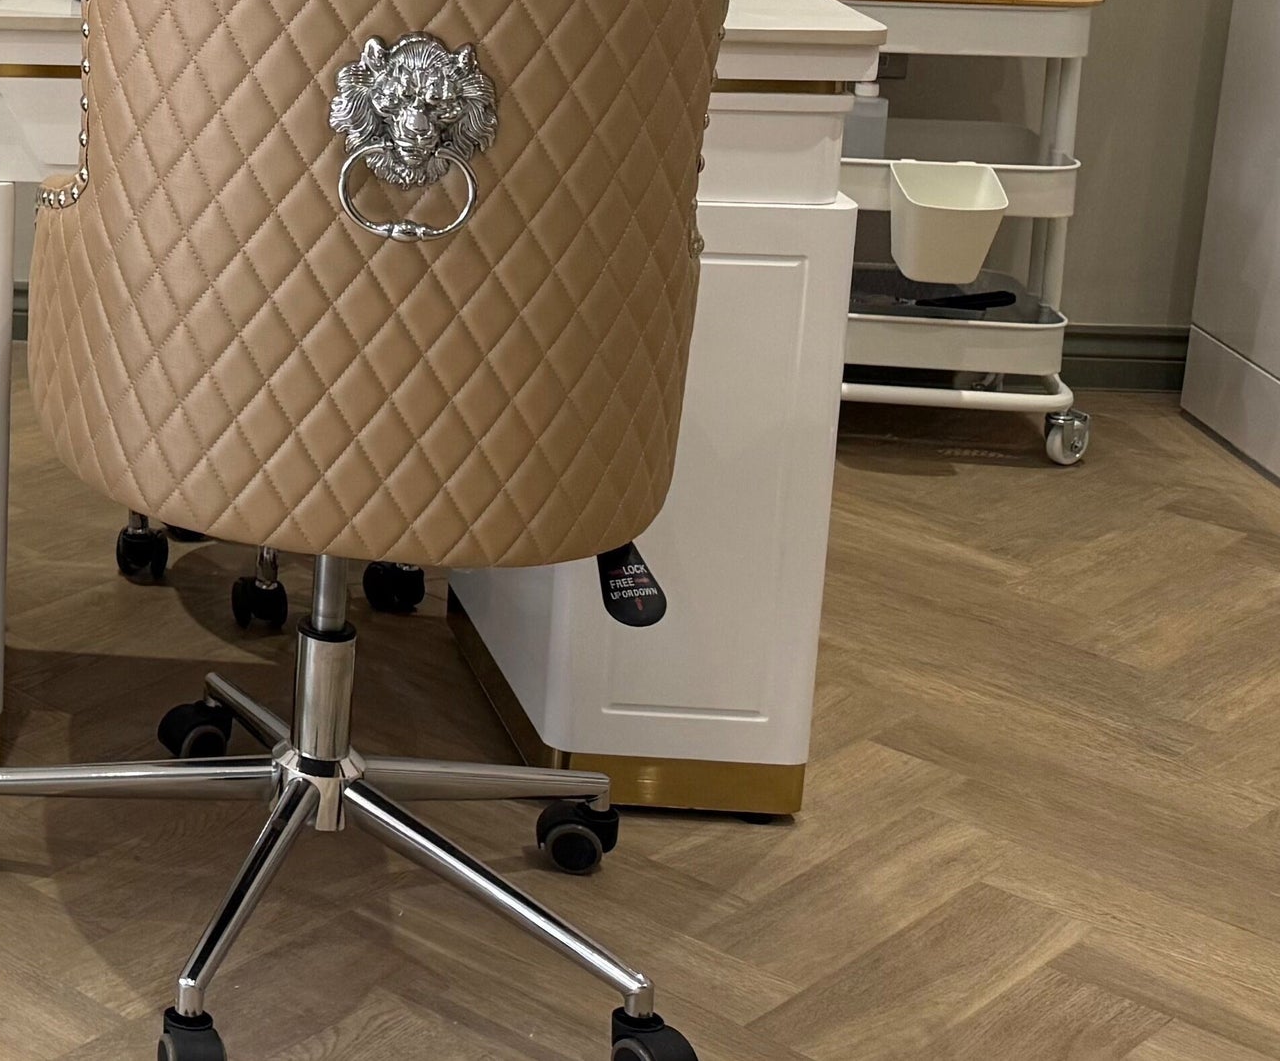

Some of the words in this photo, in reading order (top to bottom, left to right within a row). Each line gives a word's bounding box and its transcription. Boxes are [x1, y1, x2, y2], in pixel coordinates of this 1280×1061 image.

[622, 564, 648, 575] LOCK
[609, 577, 635, 589] FREE
[610, 591, 621, 600] UP
[622, 589, 634, 598] OR
[634, 587, 658, 597] DOWN
